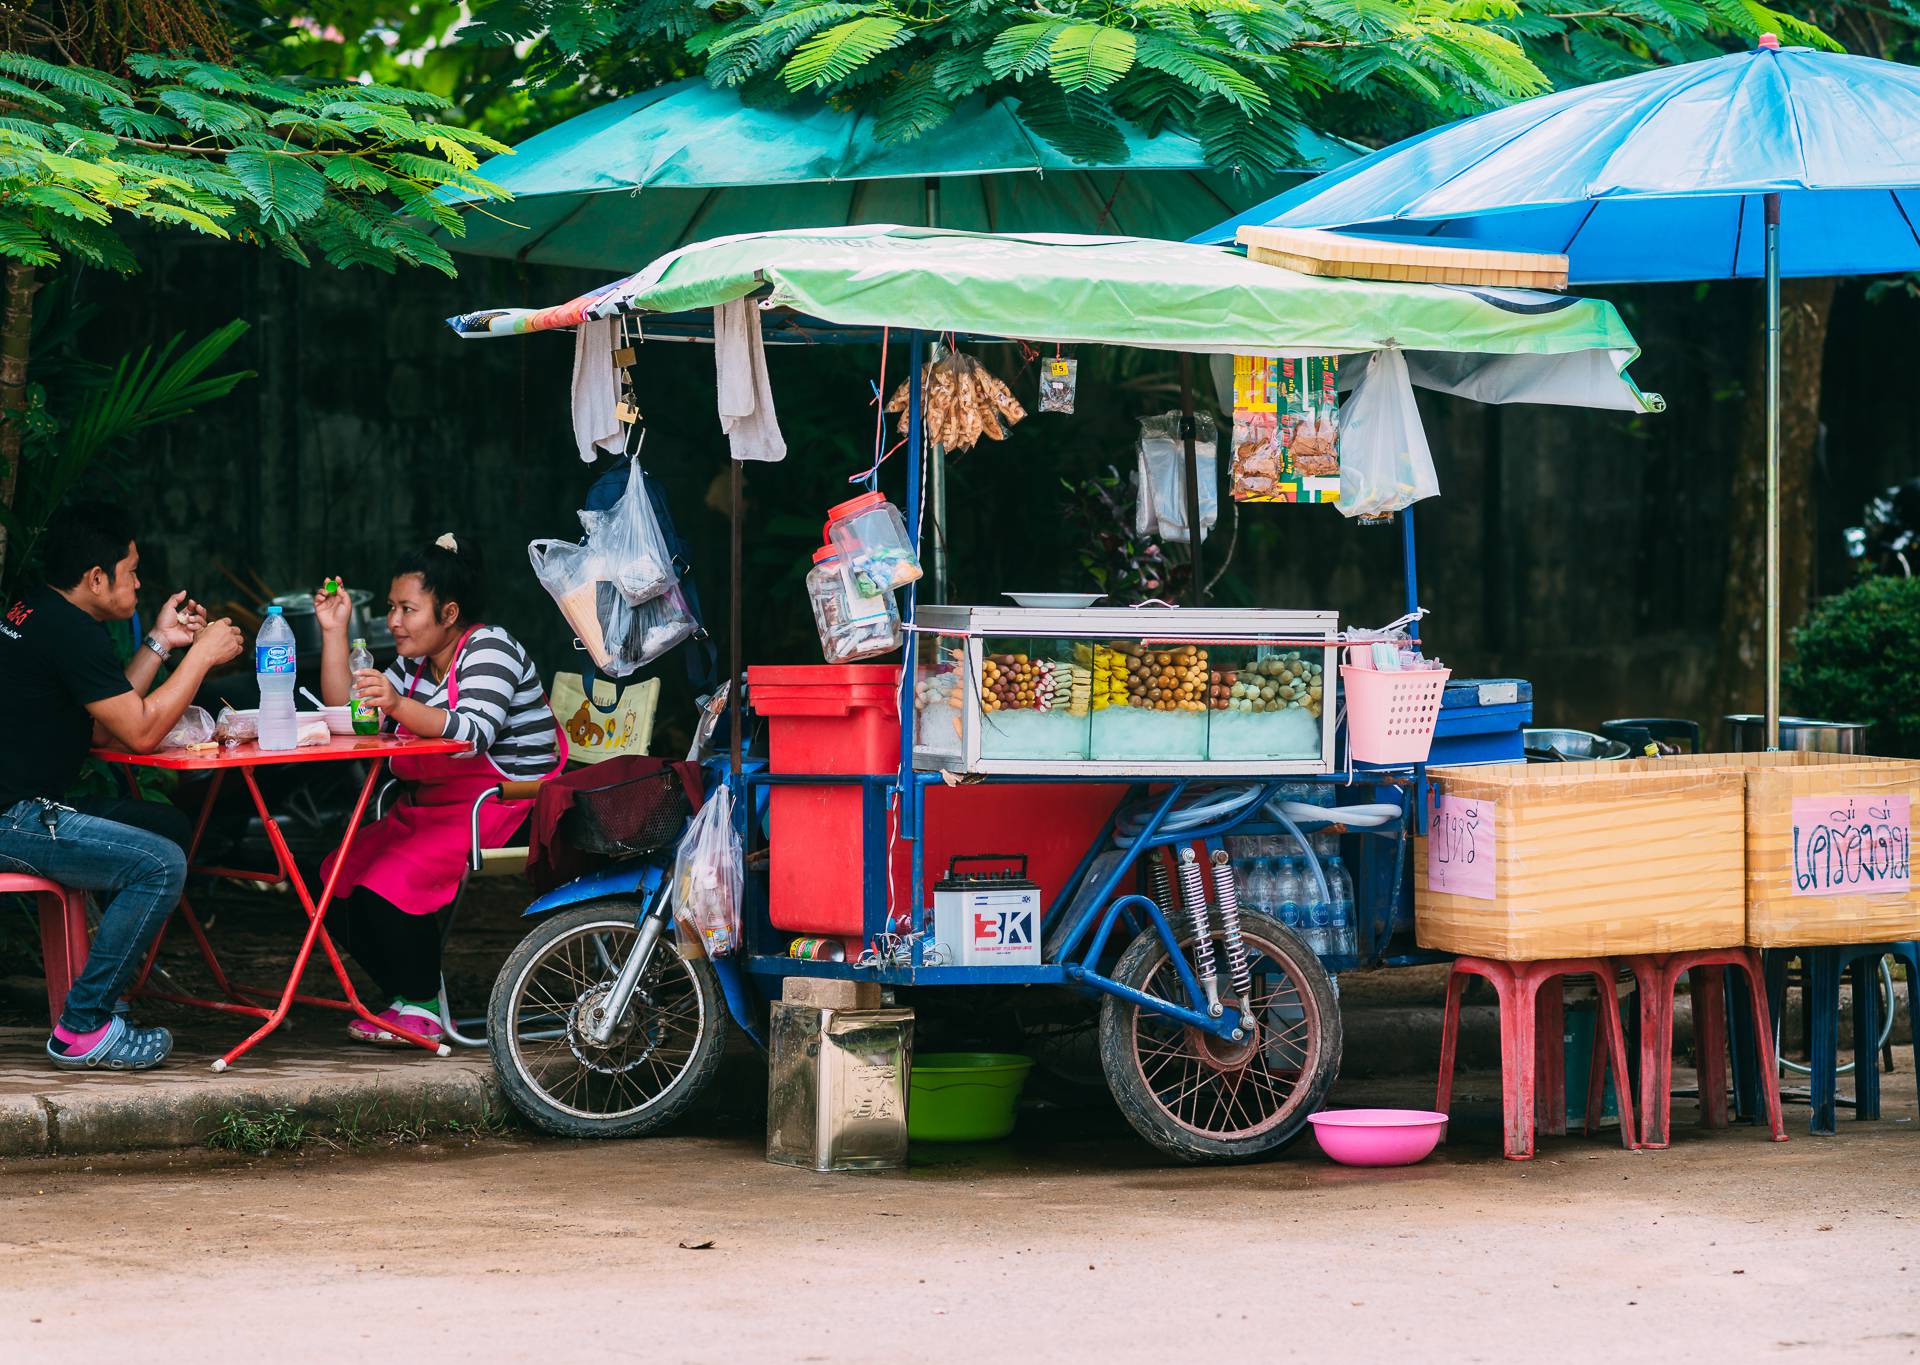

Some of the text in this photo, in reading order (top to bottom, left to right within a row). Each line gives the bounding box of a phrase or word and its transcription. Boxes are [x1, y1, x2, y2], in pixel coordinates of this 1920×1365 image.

[1793, 799, 1910, 891] เครื่องดื่ม
